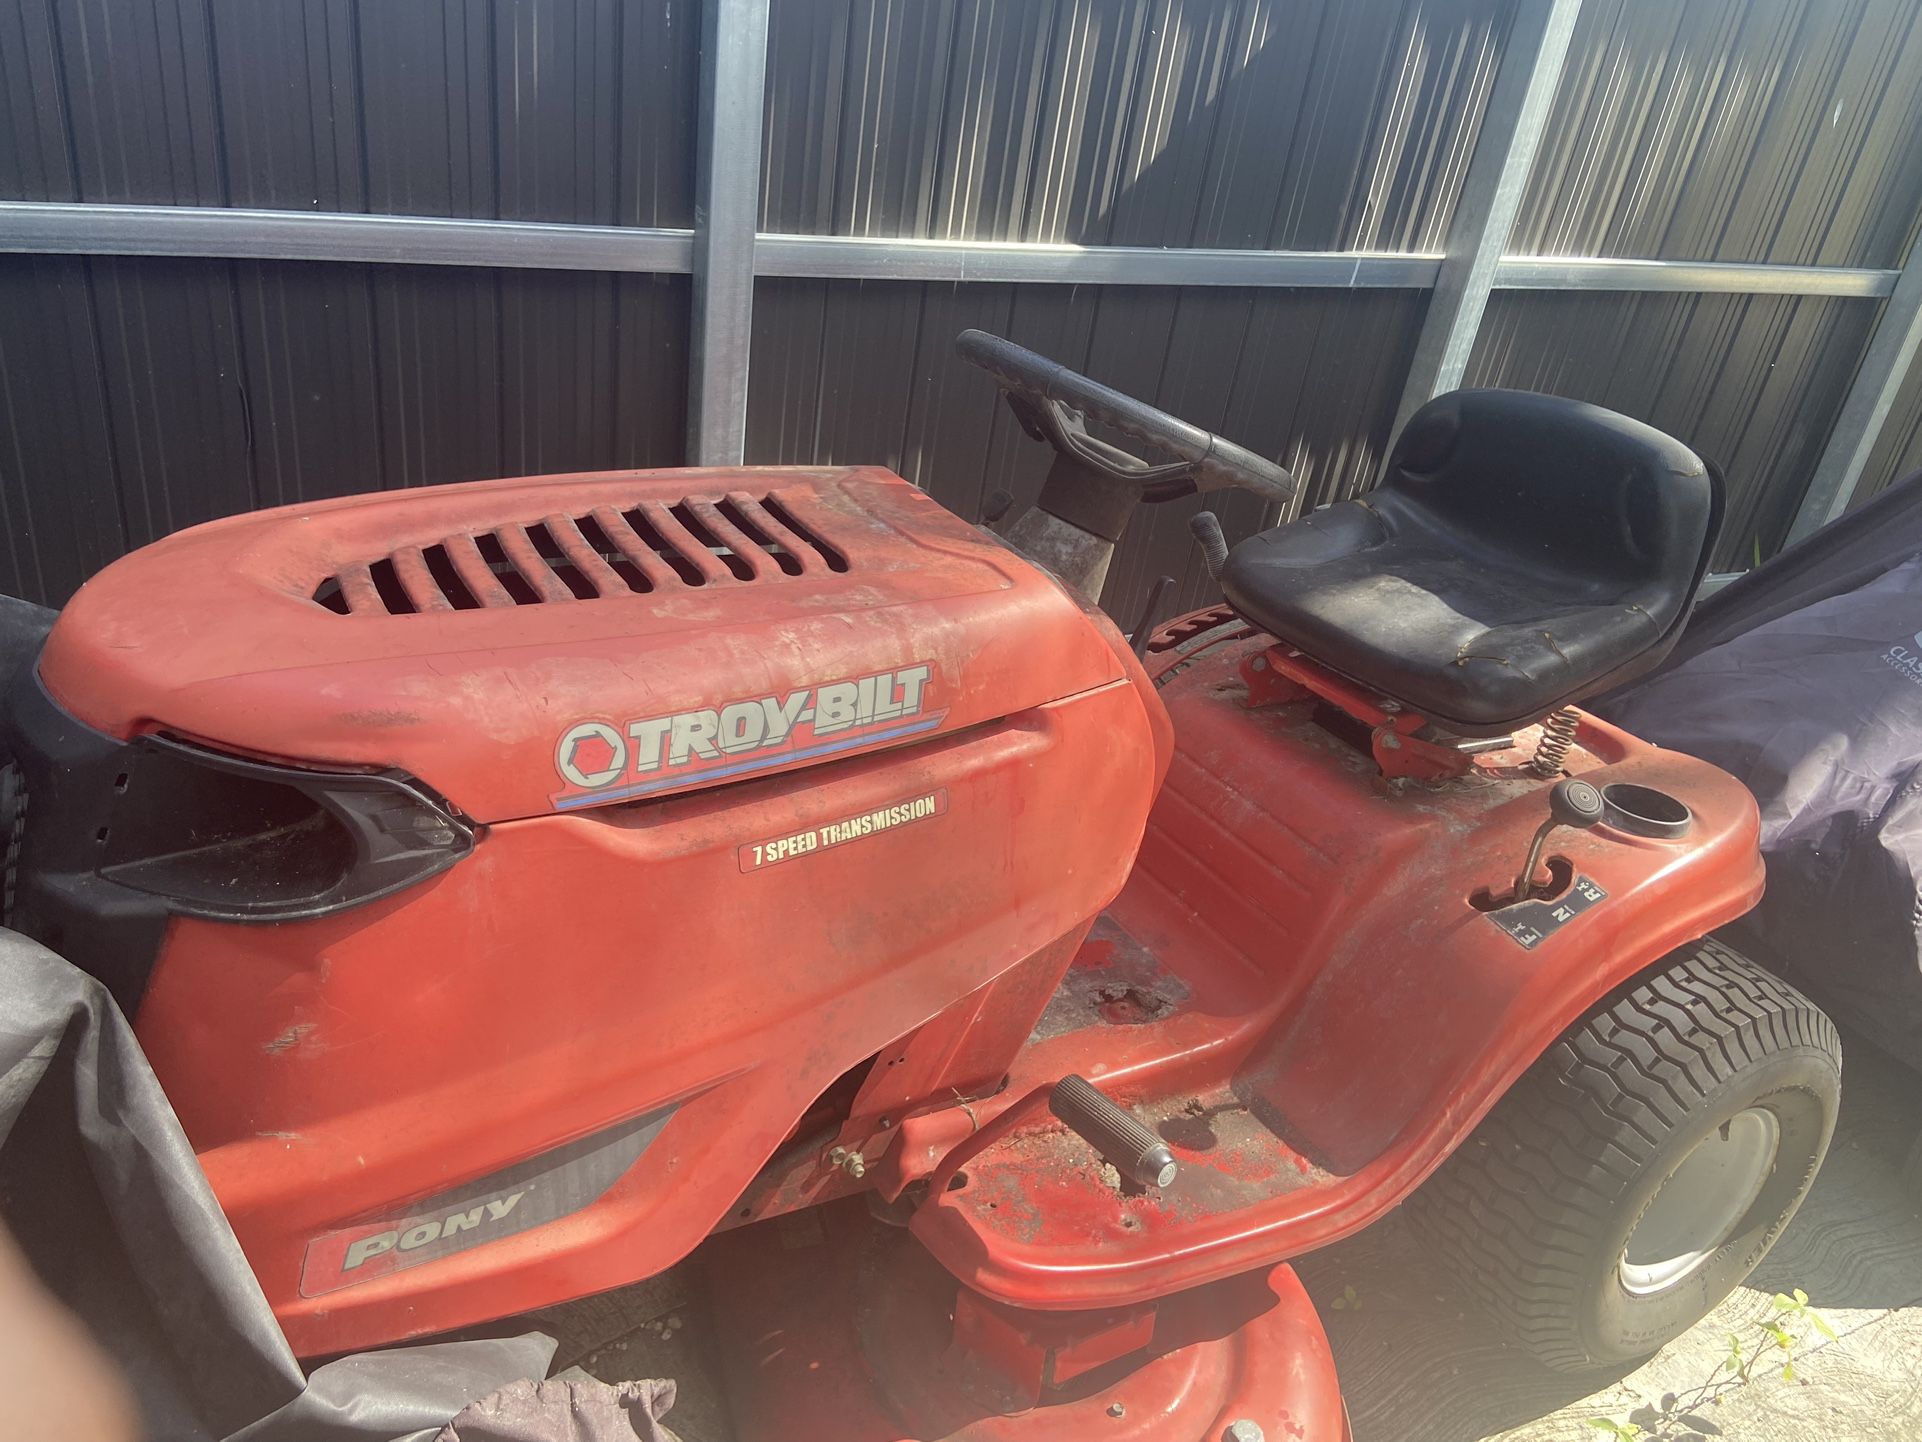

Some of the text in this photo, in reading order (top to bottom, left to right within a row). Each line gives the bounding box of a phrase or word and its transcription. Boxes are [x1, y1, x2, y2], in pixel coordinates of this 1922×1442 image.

[628, 665, 929, 772] TROY-BILT
[752, 795, 936, 866] 7 SPEED TRANSMISSION
[1551, 907, 1572, 922] N
[1583, 887, 1602, 902] R
[1519, 933, 1538, 945] F
[342, 1191, 526, 1270] PONY
